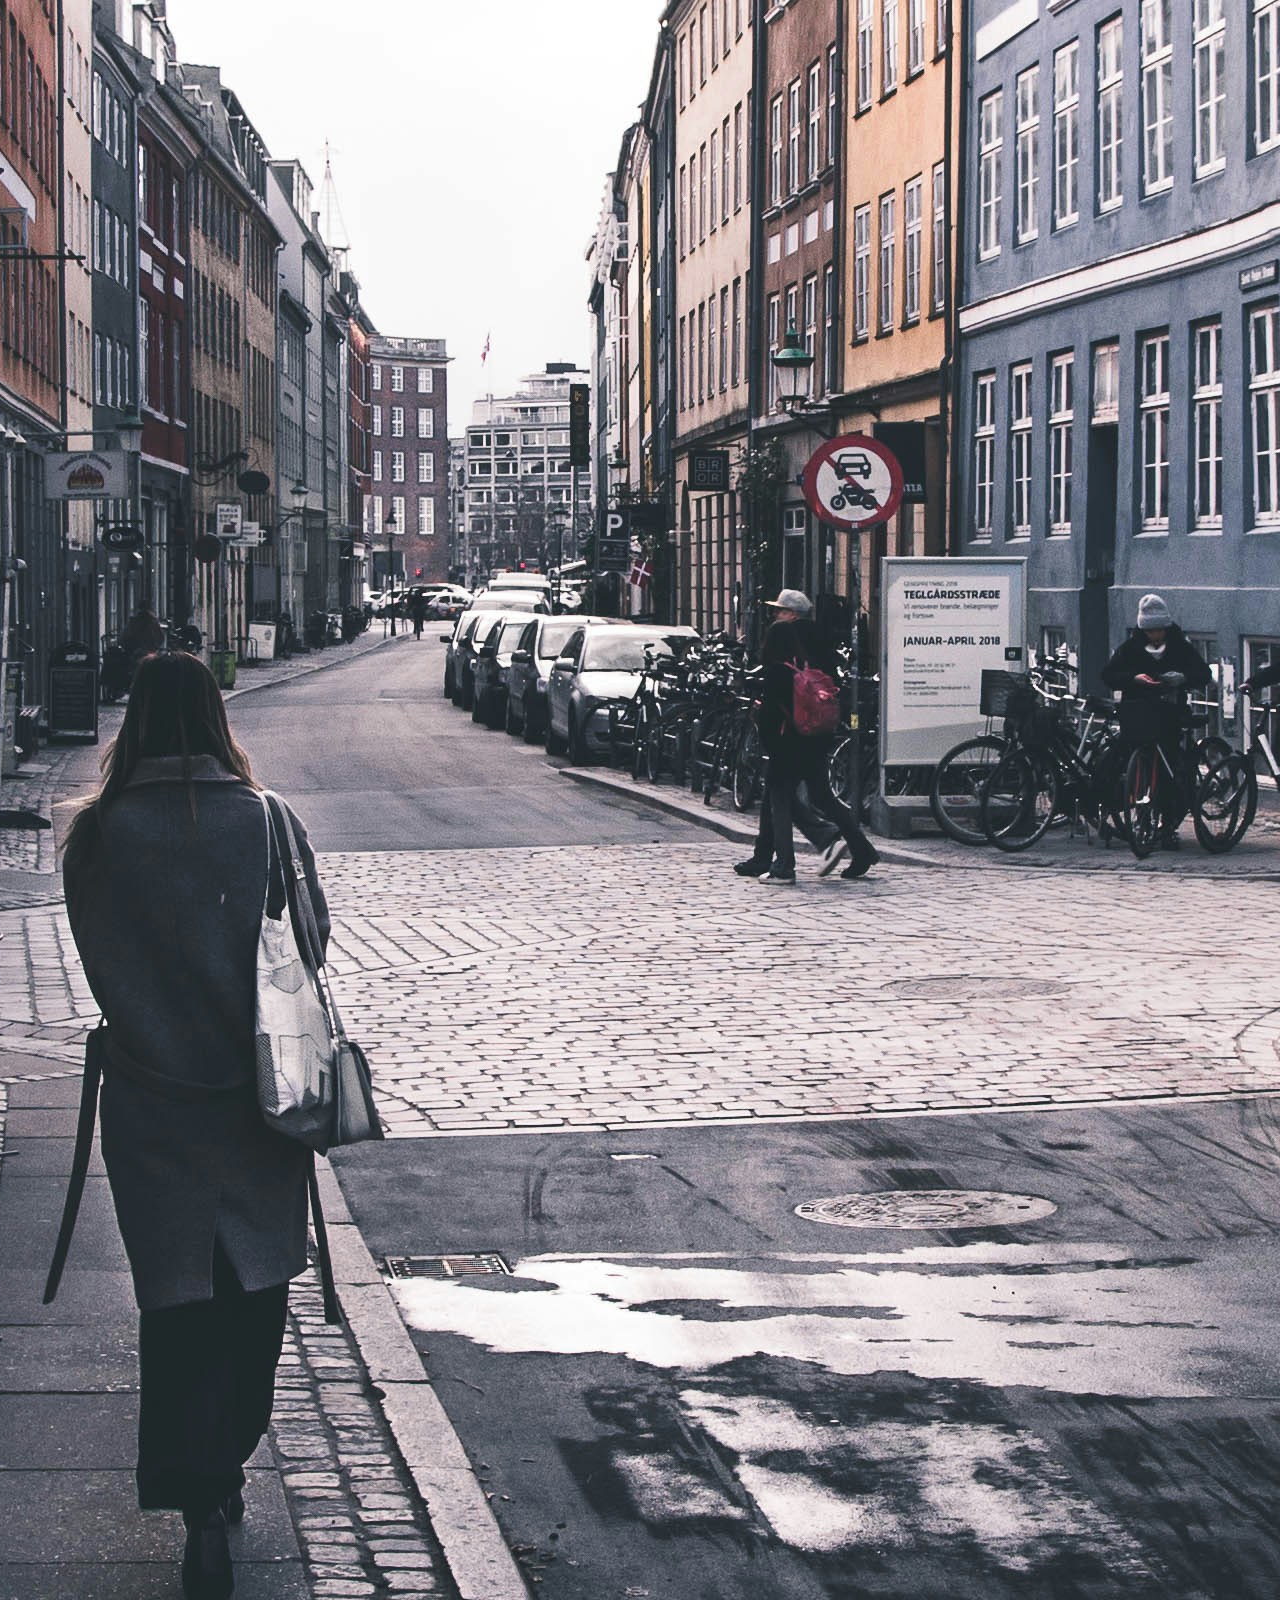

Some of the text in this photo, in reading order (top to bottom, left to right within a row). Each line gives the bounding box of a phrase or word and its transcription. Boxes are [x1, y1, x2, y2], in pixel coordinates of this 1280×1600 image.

[606, 514, 623, 537] P
[903, 589, 1001, 600] TEGLGÅRDSSTRÆDE
[903, 636, 1001, 647] JANUAR-APRIL 2018
